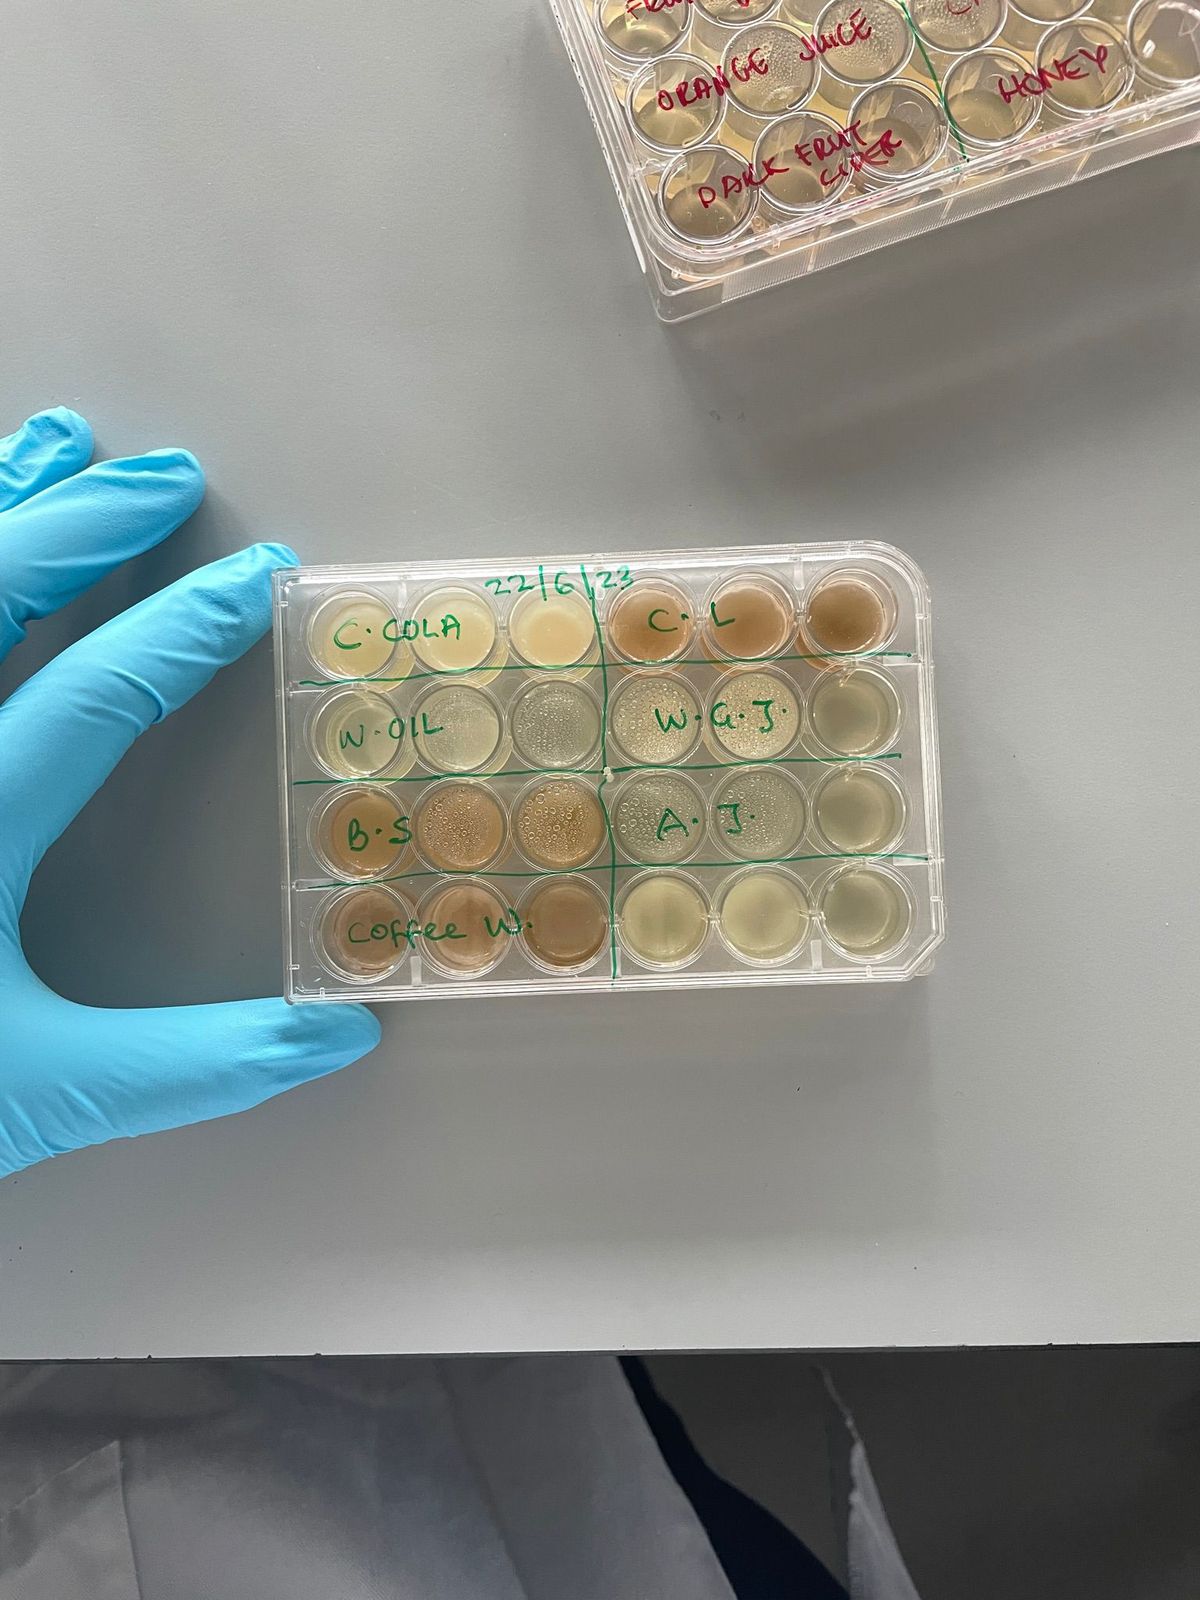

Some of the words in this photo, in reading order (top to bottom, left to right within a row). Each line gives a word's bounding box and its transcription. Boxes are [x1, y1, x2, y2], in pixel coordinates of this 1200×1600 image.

[657, 48, 769, 111] ORANGE
[799, 8, 873, 61] JUICE
[997, 44, 1109, 104] HONEY
[697, 156, 790, 209] DARK
[484, 563, 634, 602] 22/6/23
